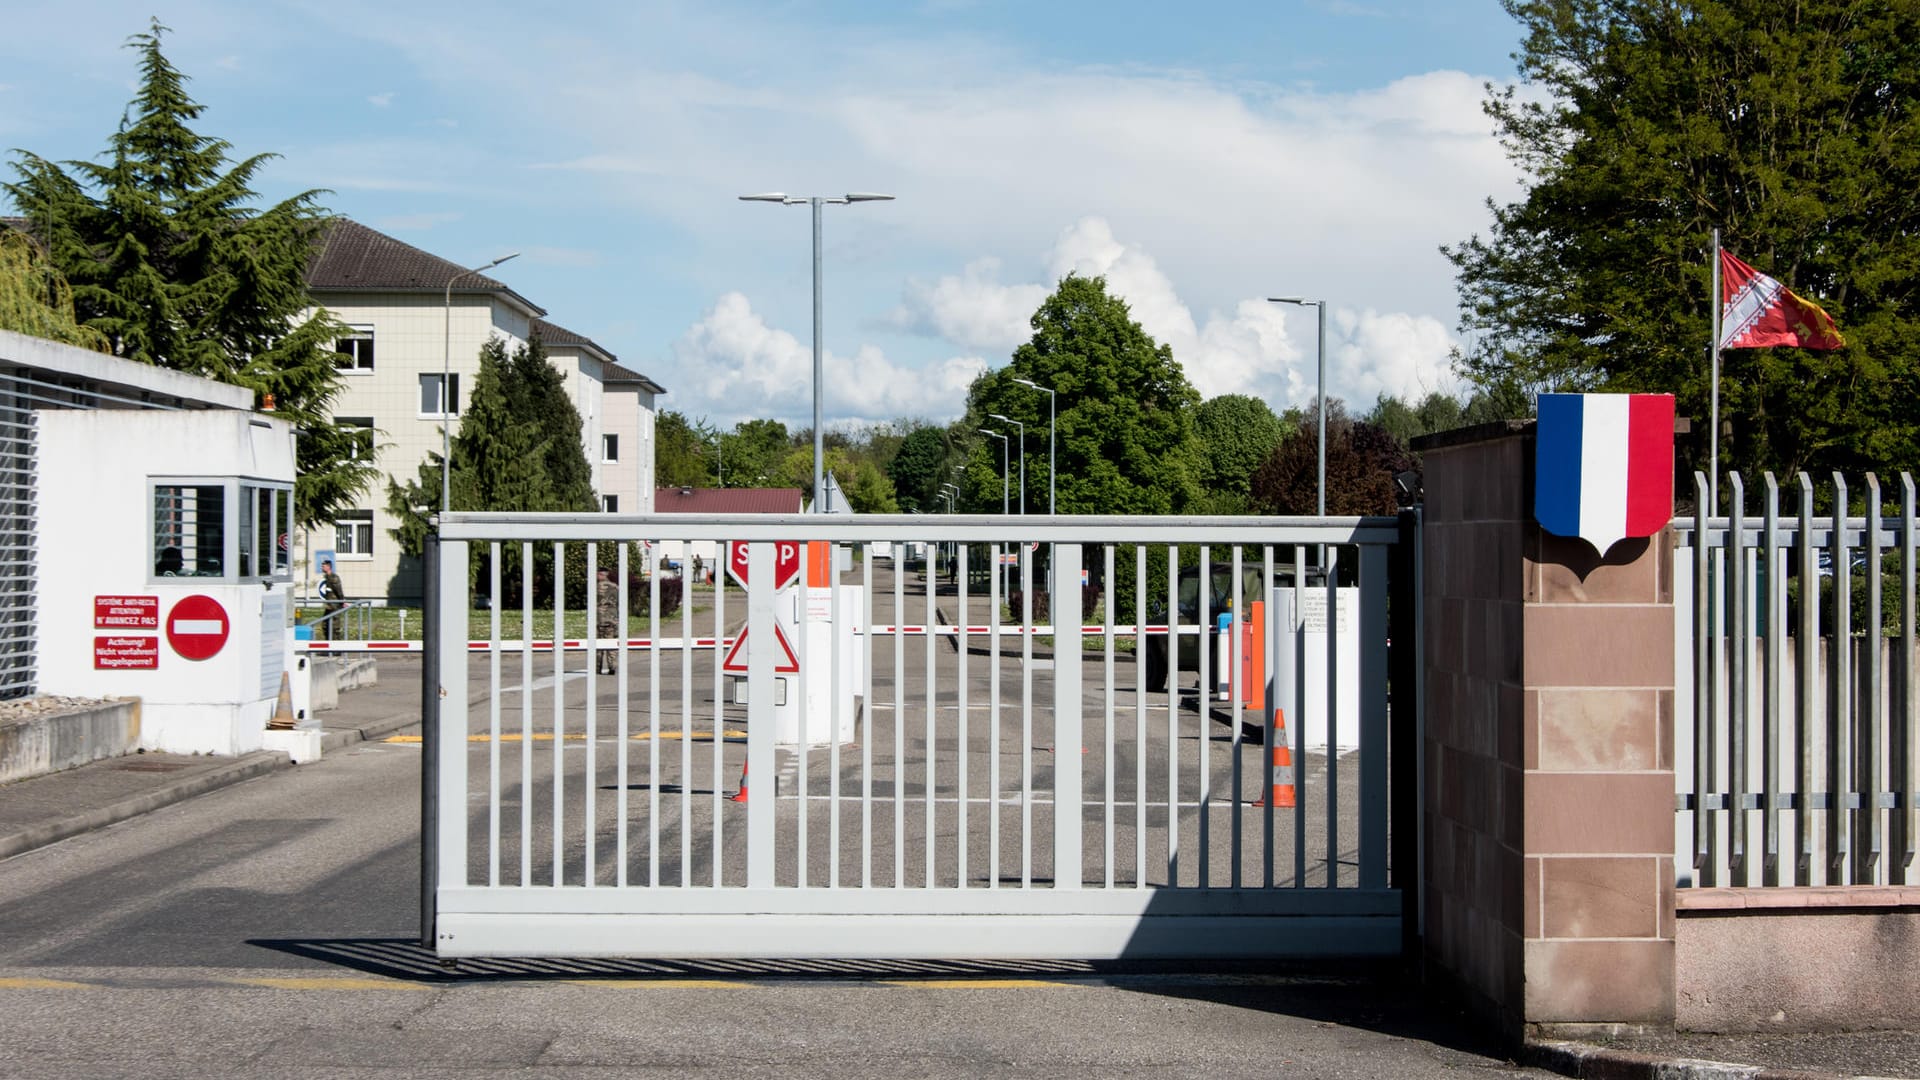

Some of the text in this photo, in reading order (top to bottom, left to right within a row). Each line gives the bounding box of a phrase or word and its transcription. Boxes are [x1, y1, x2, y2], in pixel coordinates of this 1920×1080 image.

[737, 544, 794, 566] SP
[141, 616, 156, 625] PAS
[96, 647, 117, 656] Nicht
